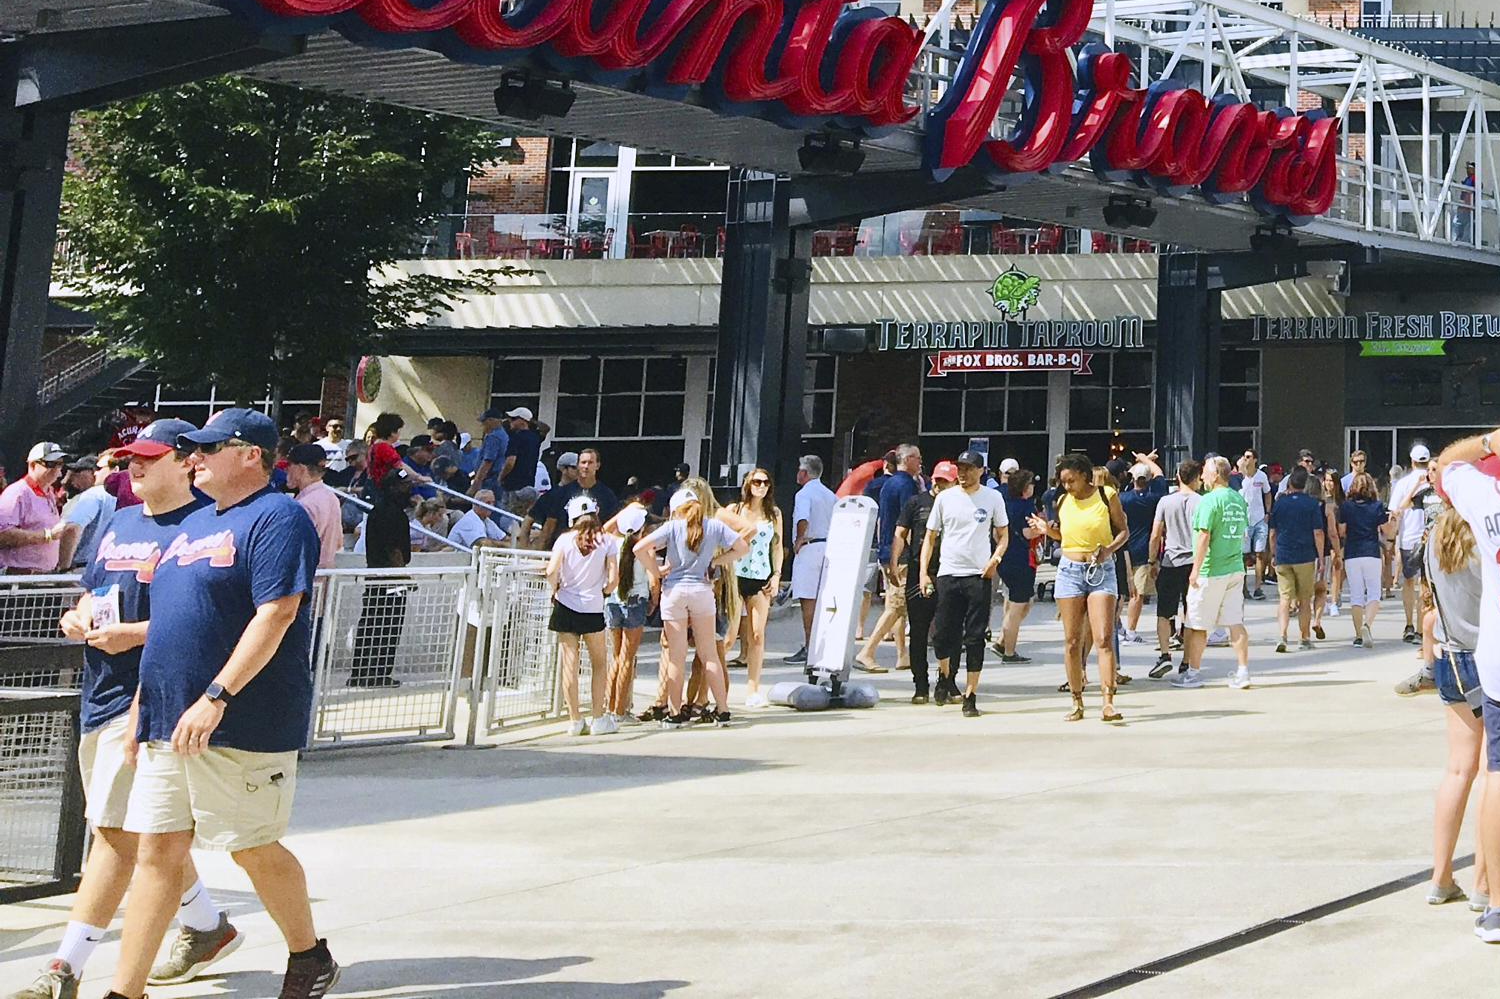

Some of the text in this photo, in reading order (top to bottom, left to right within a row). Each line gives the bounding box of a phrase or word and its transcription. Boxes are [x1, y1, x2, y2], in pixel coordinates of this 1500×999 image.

[874, 315, 1145, 351] TERRAPIN TAPROOM
[1251, 314, 1360, 341] TERRAPIN
[1364, 311, 1434, 340] FRESH
[956, 354, 981, 367] FOX
[985, 353, 1023, 366] BROS.
[1027, 353, 1080, 366] BAR-B-Q
